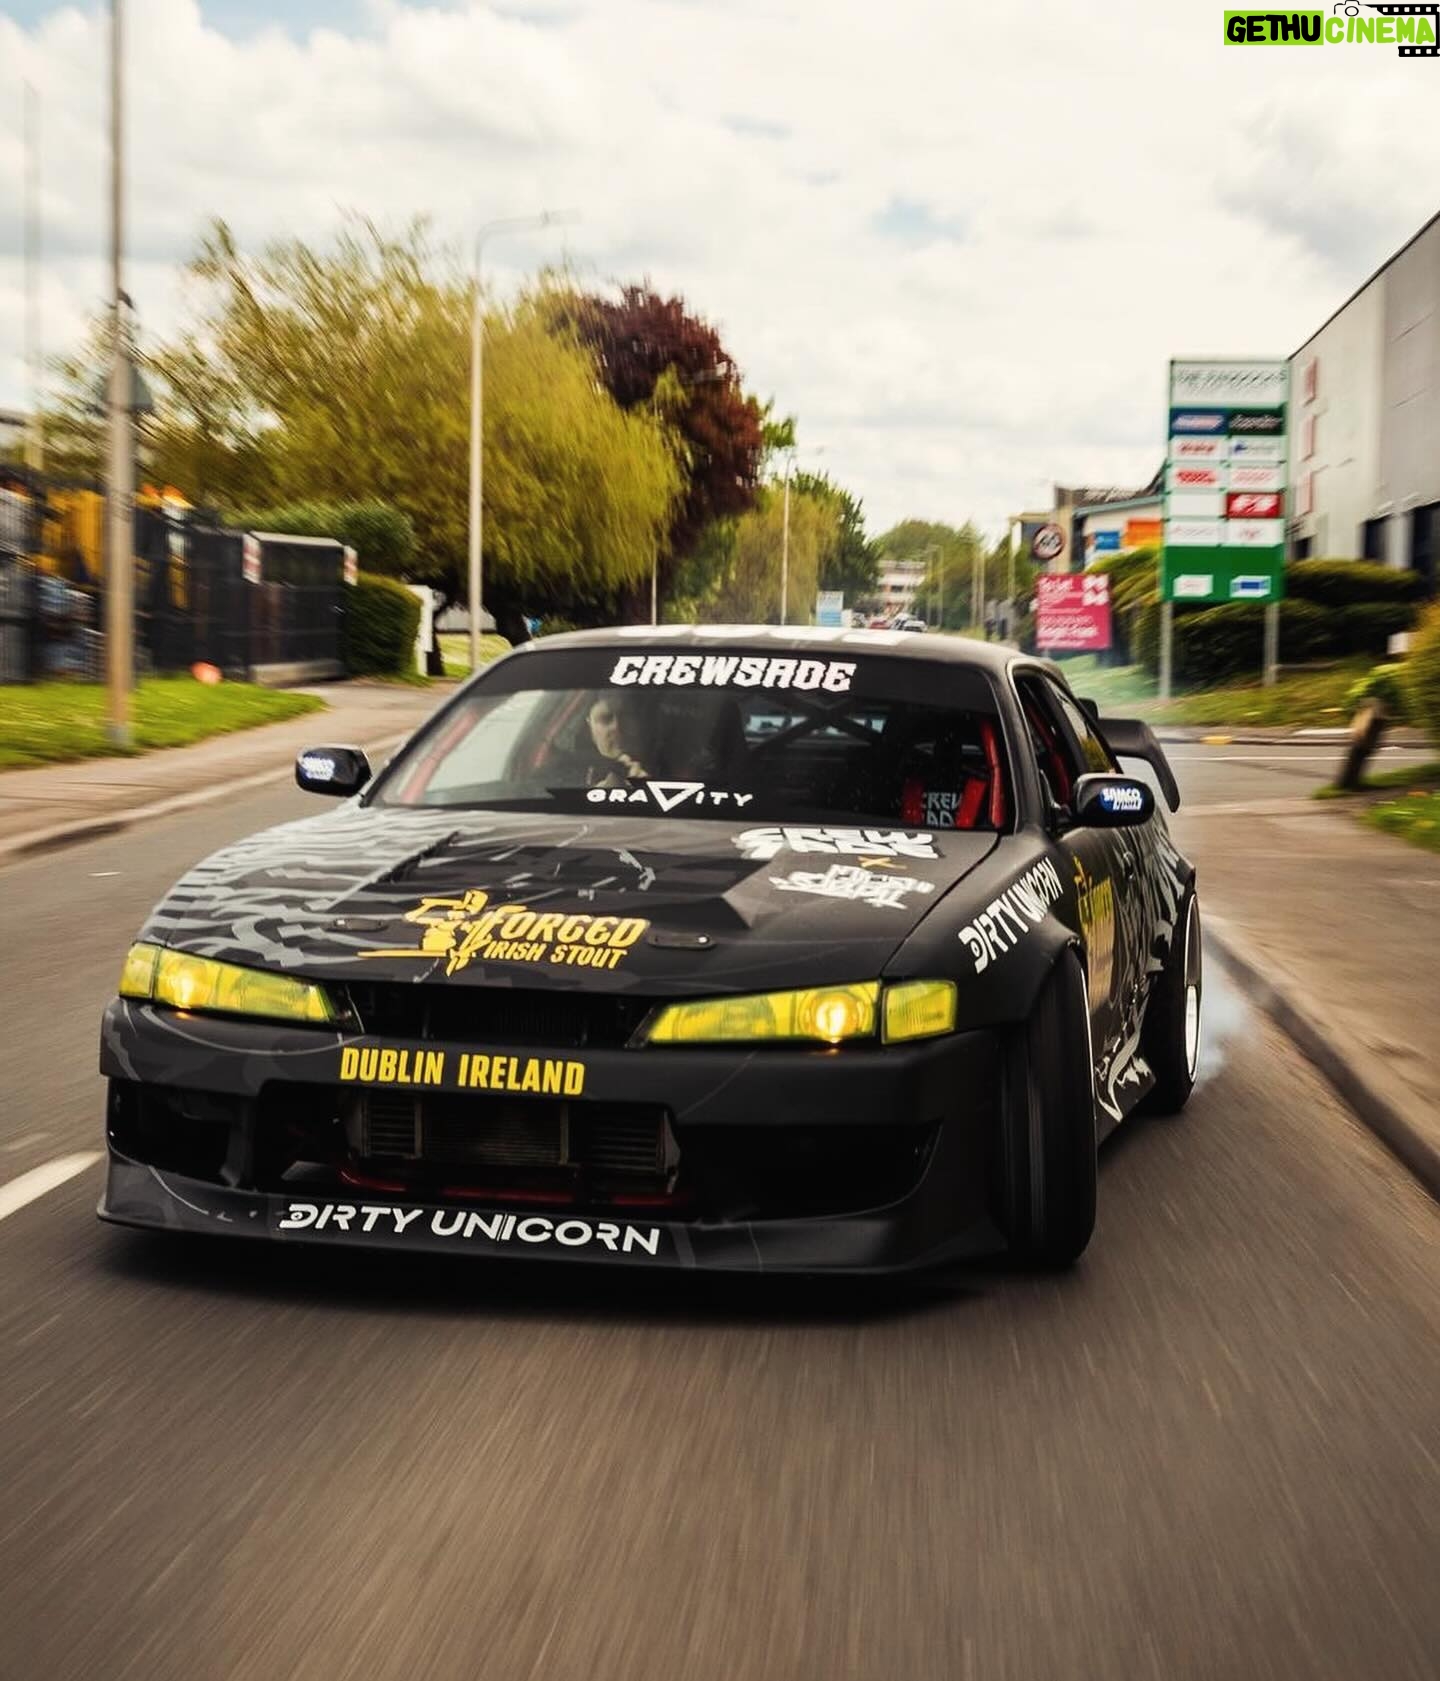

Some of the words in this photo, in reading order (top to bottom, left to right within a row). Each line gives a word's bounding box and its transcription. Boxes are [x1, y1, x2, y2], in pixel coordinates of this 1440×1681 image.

[609, 655, 857, 692] CREWSADE
[586, 781, 753, 812] GRAVITY
[474, 903, 650, 949] FORGED
[958, 893, 1029, 974] DIRTY
[483, 940, 547, 962] IRISH
[550, 944, 628, 969] STOUT
[340, 1047, 445, 1085] DUBLIN
[458, 1054, 585, 1096] IRELAND
[279, 1203, 423, 1233] DIRTY
[431, 1210, 660, 1255] UNICORN
